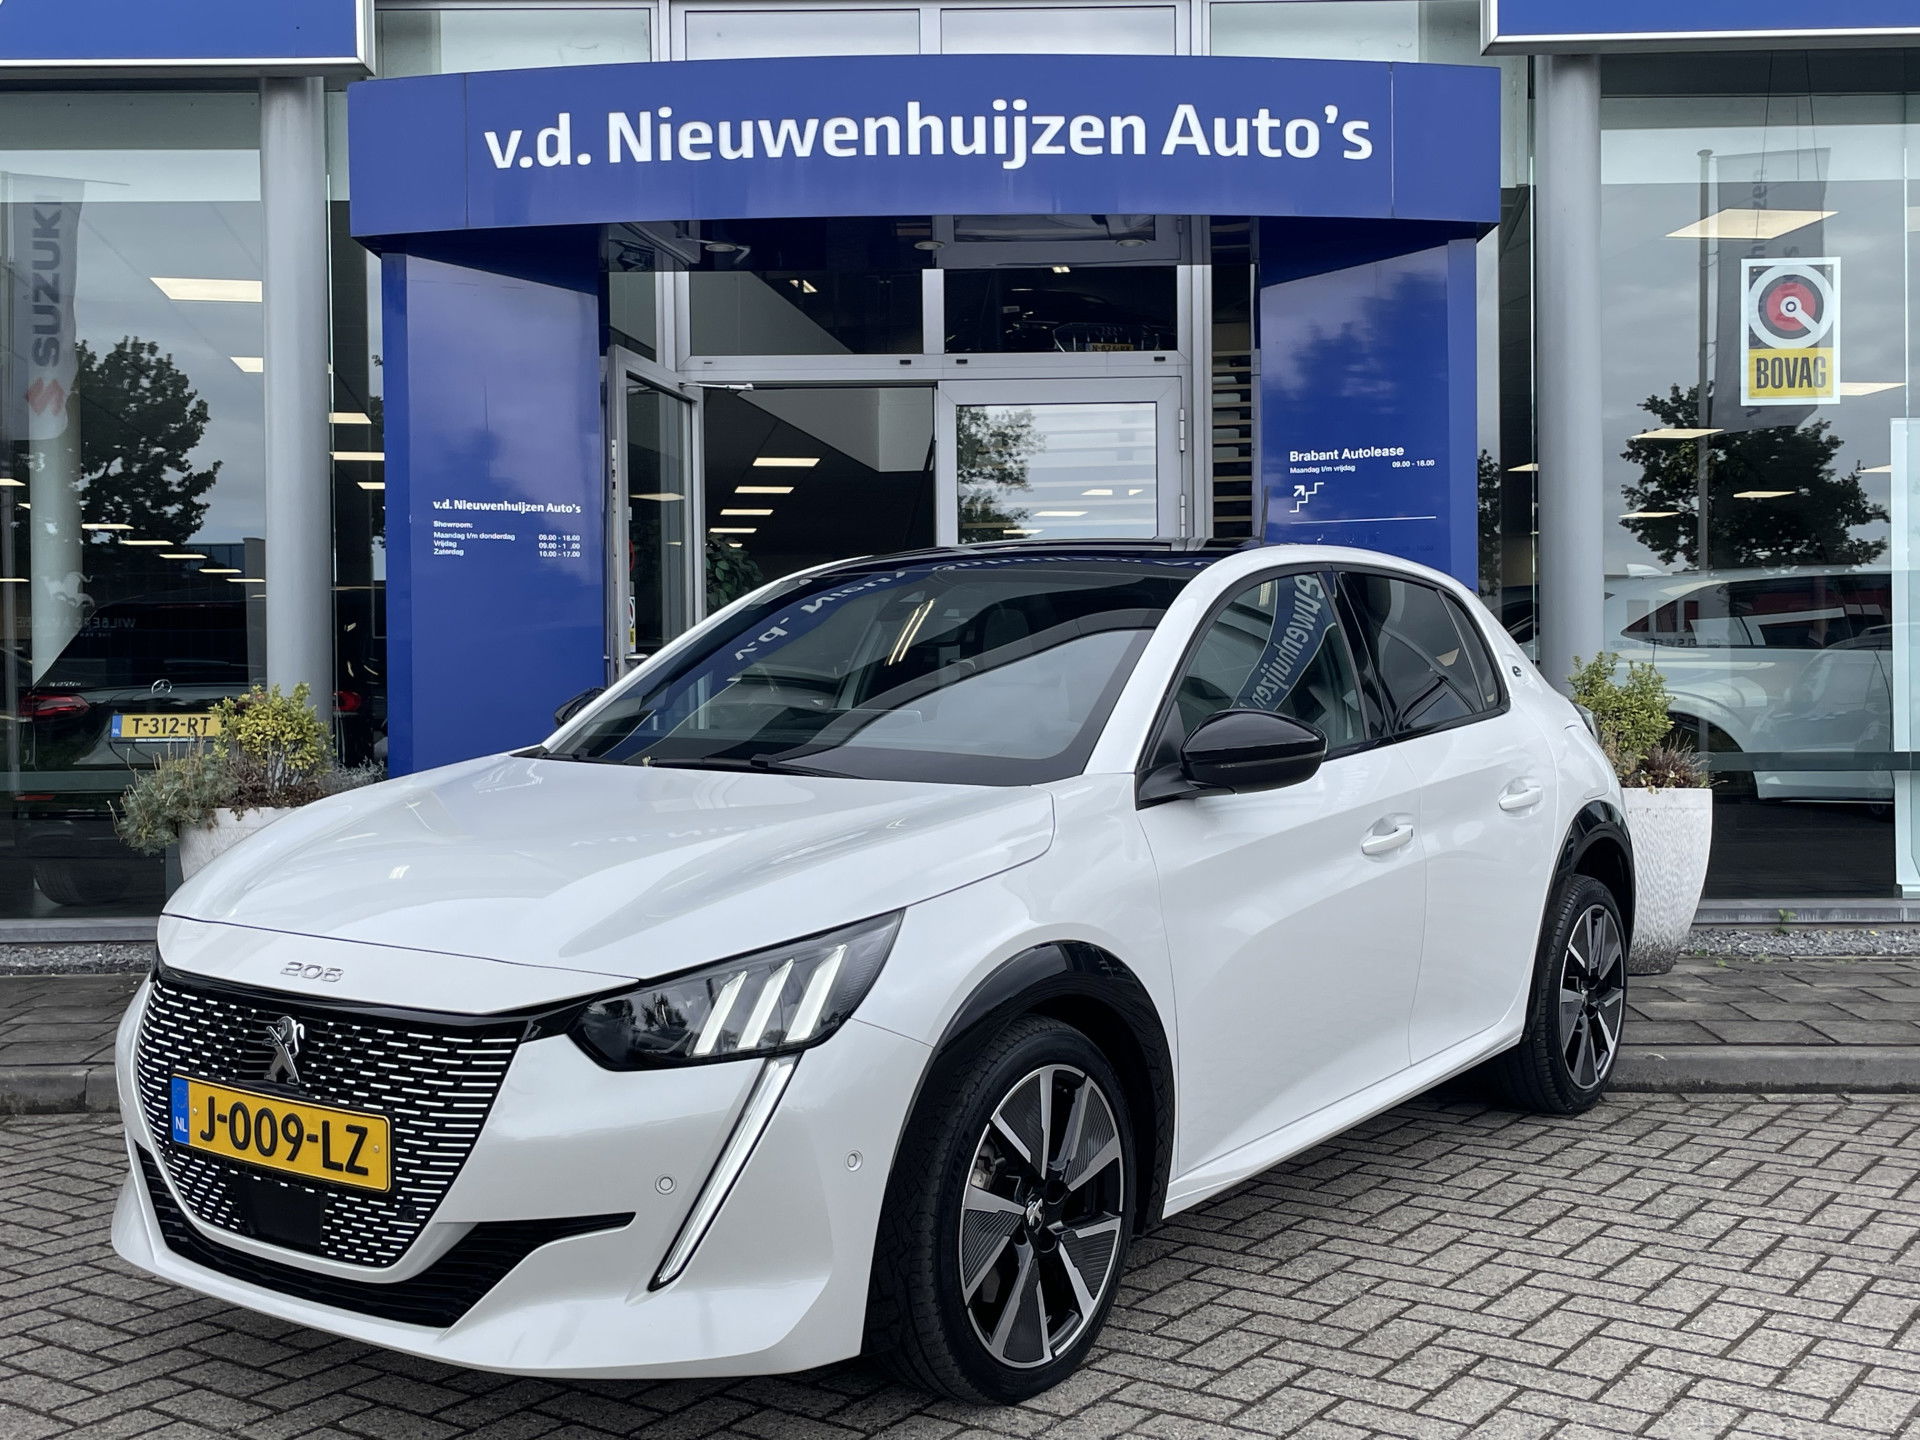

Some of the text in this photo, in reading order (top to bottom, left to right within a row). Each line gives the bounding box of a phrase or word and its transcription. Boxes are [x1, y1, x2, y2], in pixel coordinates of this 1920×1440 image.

[484, 99, 1373, 170] v.d. Nieuwenhuijzen Auto's
[31, 195, 62, 368] SUZUKI
[1756, 356, 1827, 389] BOVAG
[1289, 446, 1405, 462] Brabant Autolease
[1289, 466, 1320, 474] Maandag
[1333, 464, 1356, 473] vrijdag
[1416, 459, 1436, 467] 18.00
[433, 499, 582, 515] v.d. Nieuwenhuijzen Auto's
[433, 520, 473, 529] Showroom:
[433, 531, 466, 540] Maandag
[479, 532, 516, 541] donderdag
[433, 540, 458, 548] Vrijdag
[433, 548, 465, 556] Zaterdag
[132, 716, 212, 736] T-312-RT
[280, 961, 345, 983] 208
[175, 1095, 369, 1177] NL J-009-LZ
